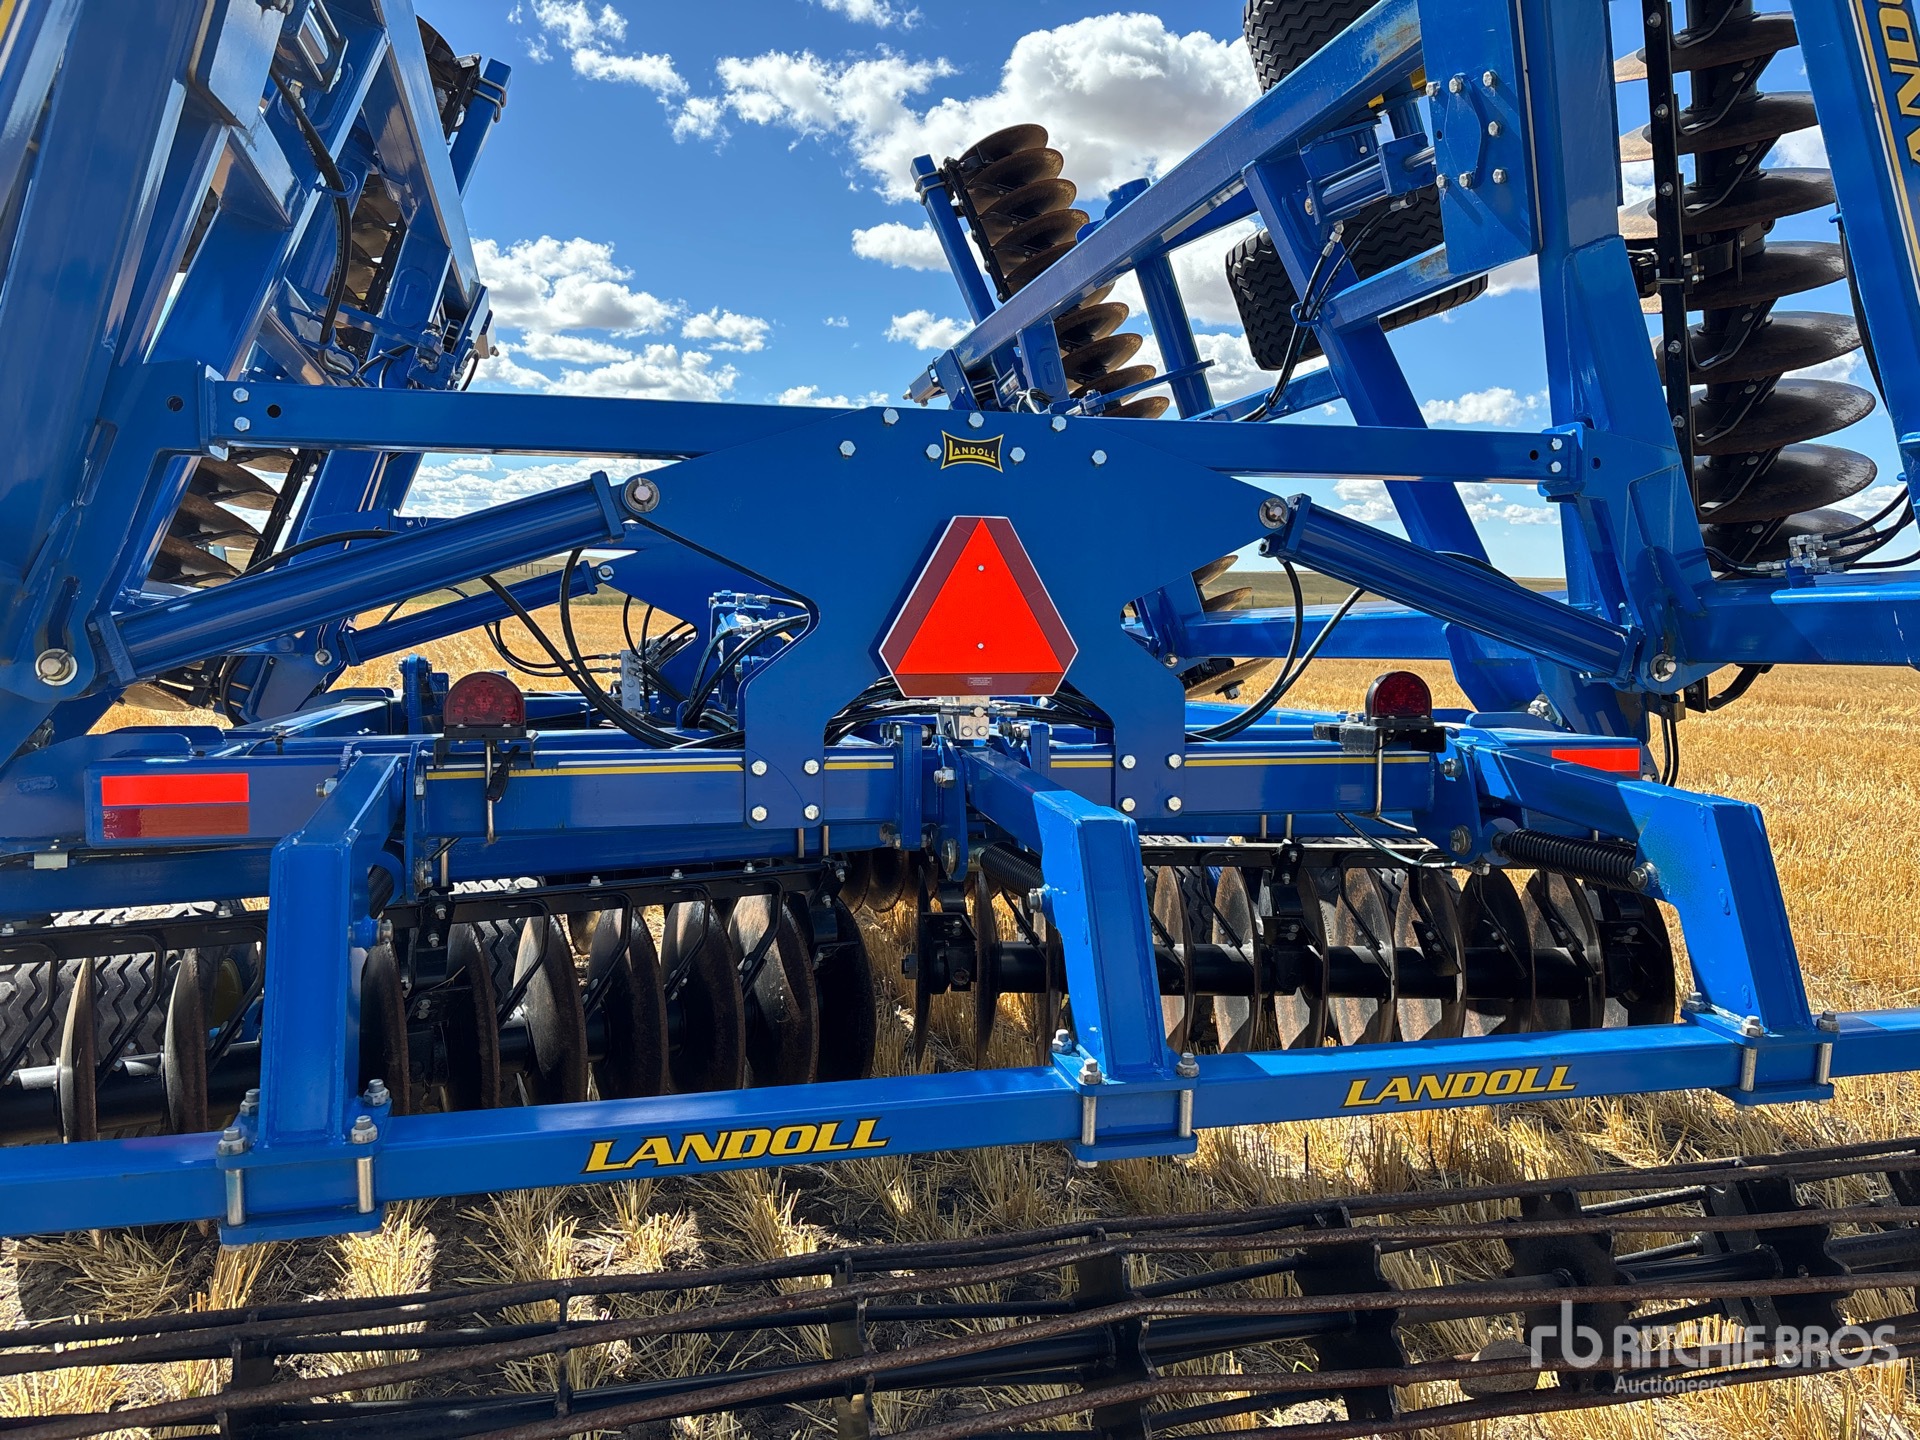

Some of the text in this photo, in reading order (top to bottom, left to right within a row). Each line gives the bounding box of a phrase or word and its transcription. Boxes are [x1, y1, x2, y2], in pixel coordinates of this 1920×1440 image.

[948, 440, 996, 463] LANDOLL
[1342, 1065, 1576, 1108] LANDOLL
[582, 1117, 891, 1173] LANDOLL
